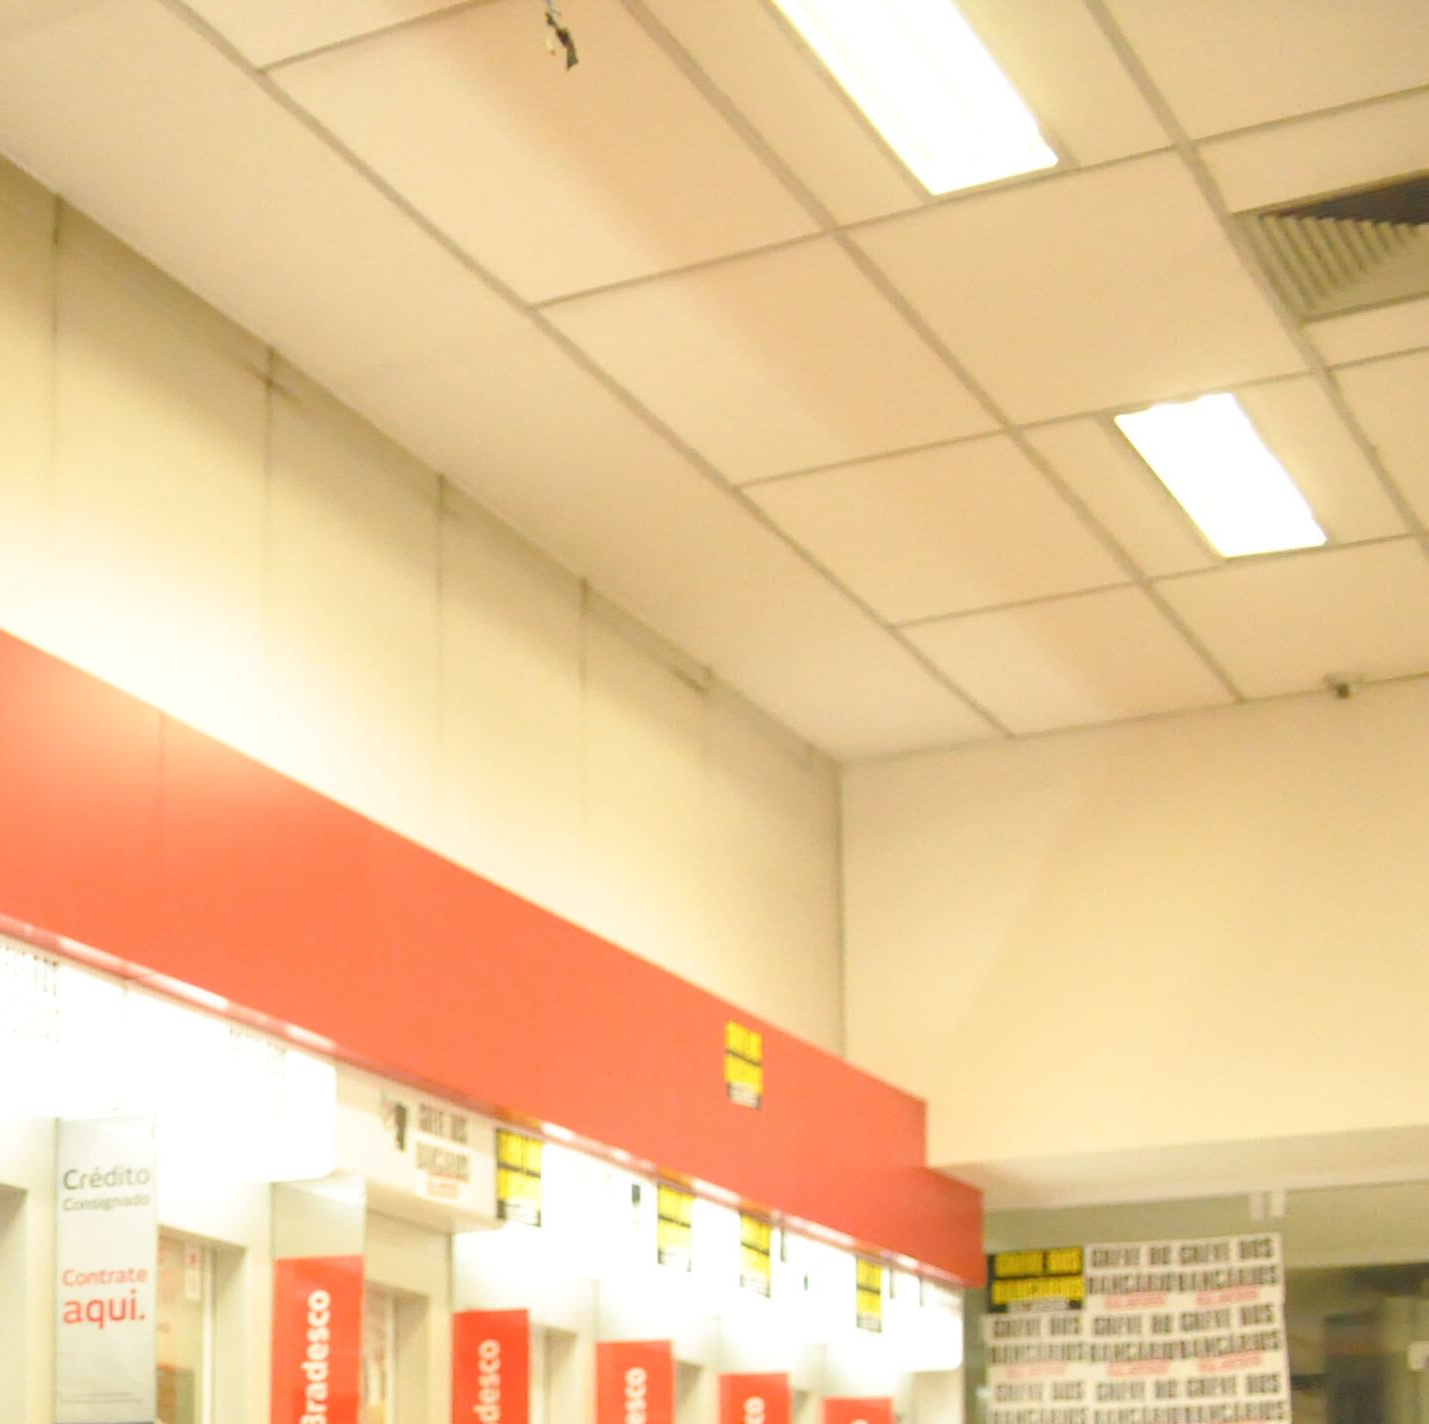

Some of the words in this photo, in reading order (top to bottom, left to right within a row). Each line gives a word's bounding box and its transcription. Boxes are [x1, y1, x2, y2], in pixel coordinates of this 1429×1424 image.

[63, 1165, 150, 1191] Crédito
[62, 1268, 149, 1287] Contrate
[63, 1287, 146, 1330] aqui.
